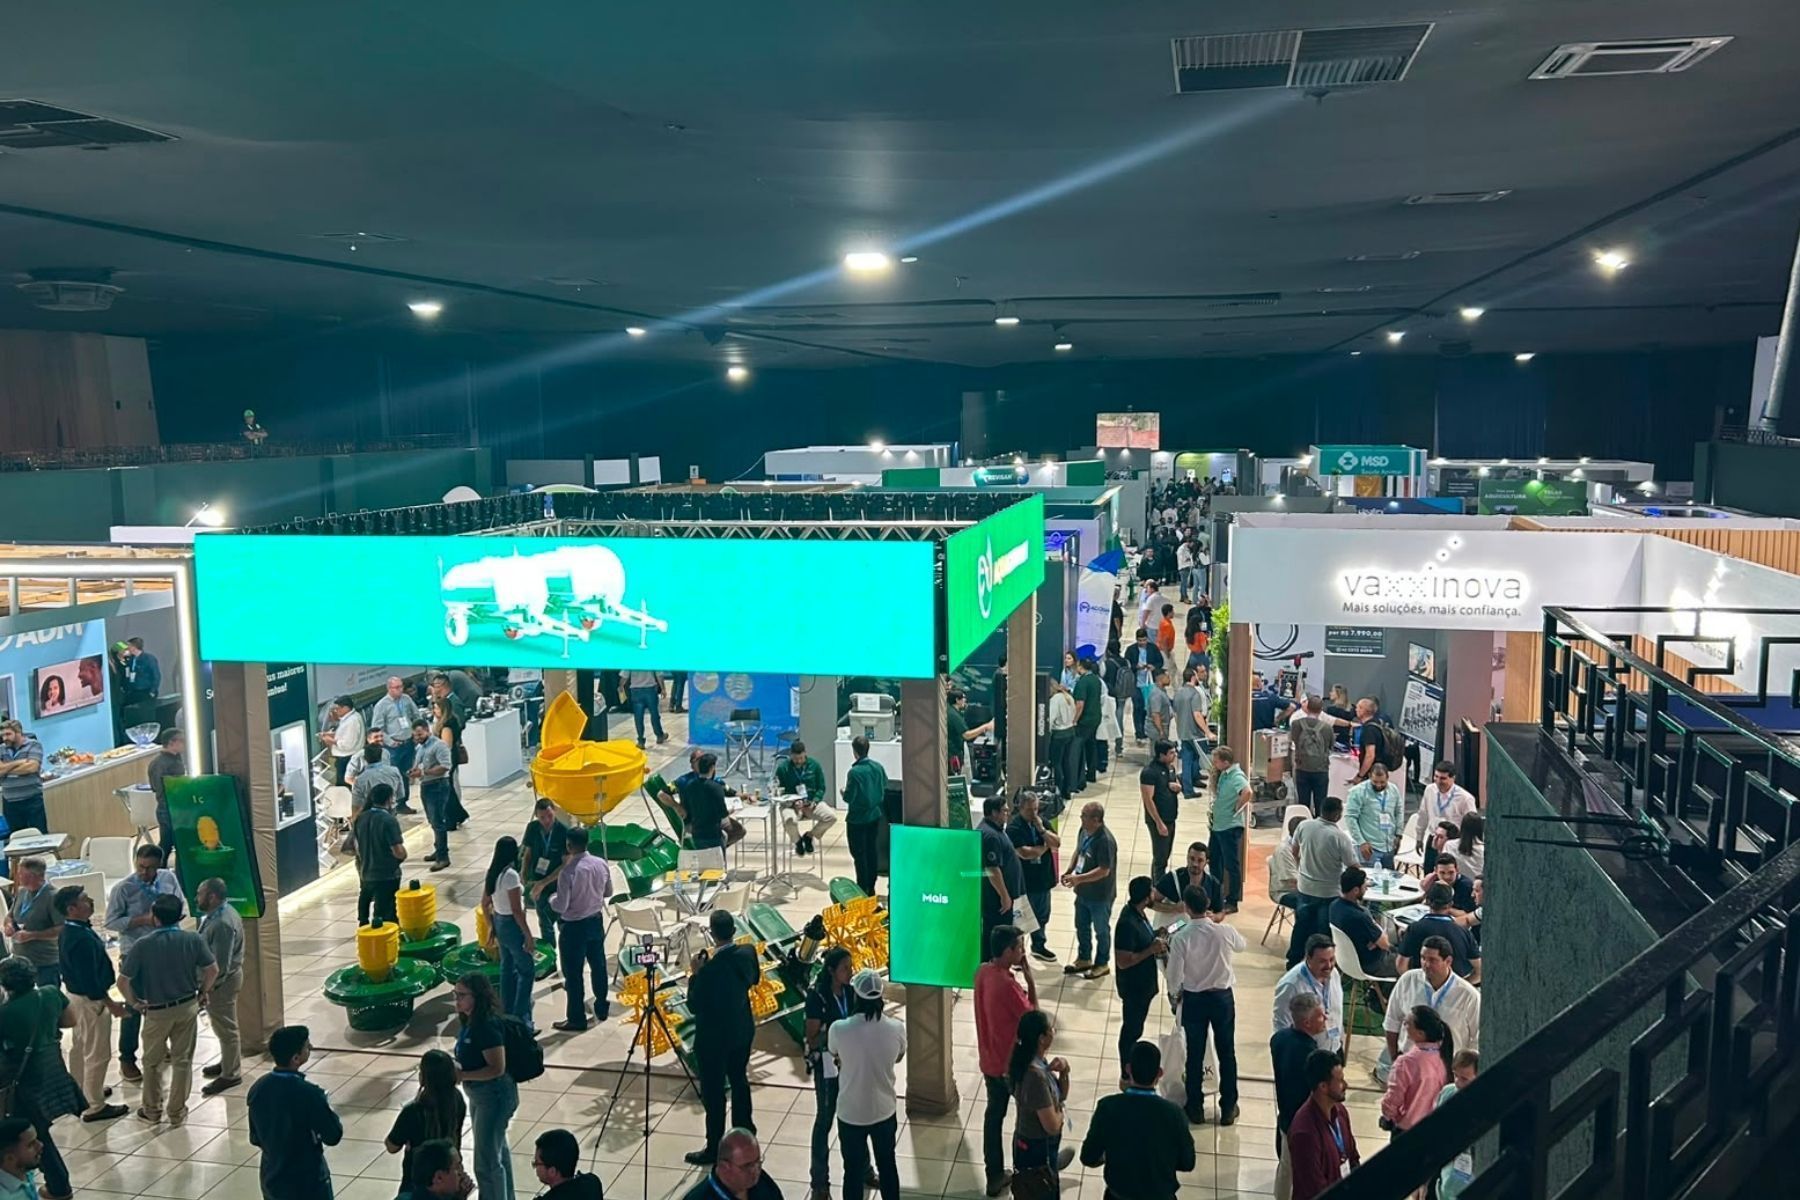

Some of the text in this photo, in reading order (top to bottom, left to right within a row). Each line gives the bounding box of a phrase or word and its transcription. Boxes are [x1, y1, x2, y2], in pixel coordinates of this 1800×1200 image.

[1361, 455, 1389, 467] MSD
[1344, 575, 1521, 600] vaxxinova
[1343, 602, 1521, 618] Mais soluções, mais confiança.
[922, 893, 949, 904] Mais
